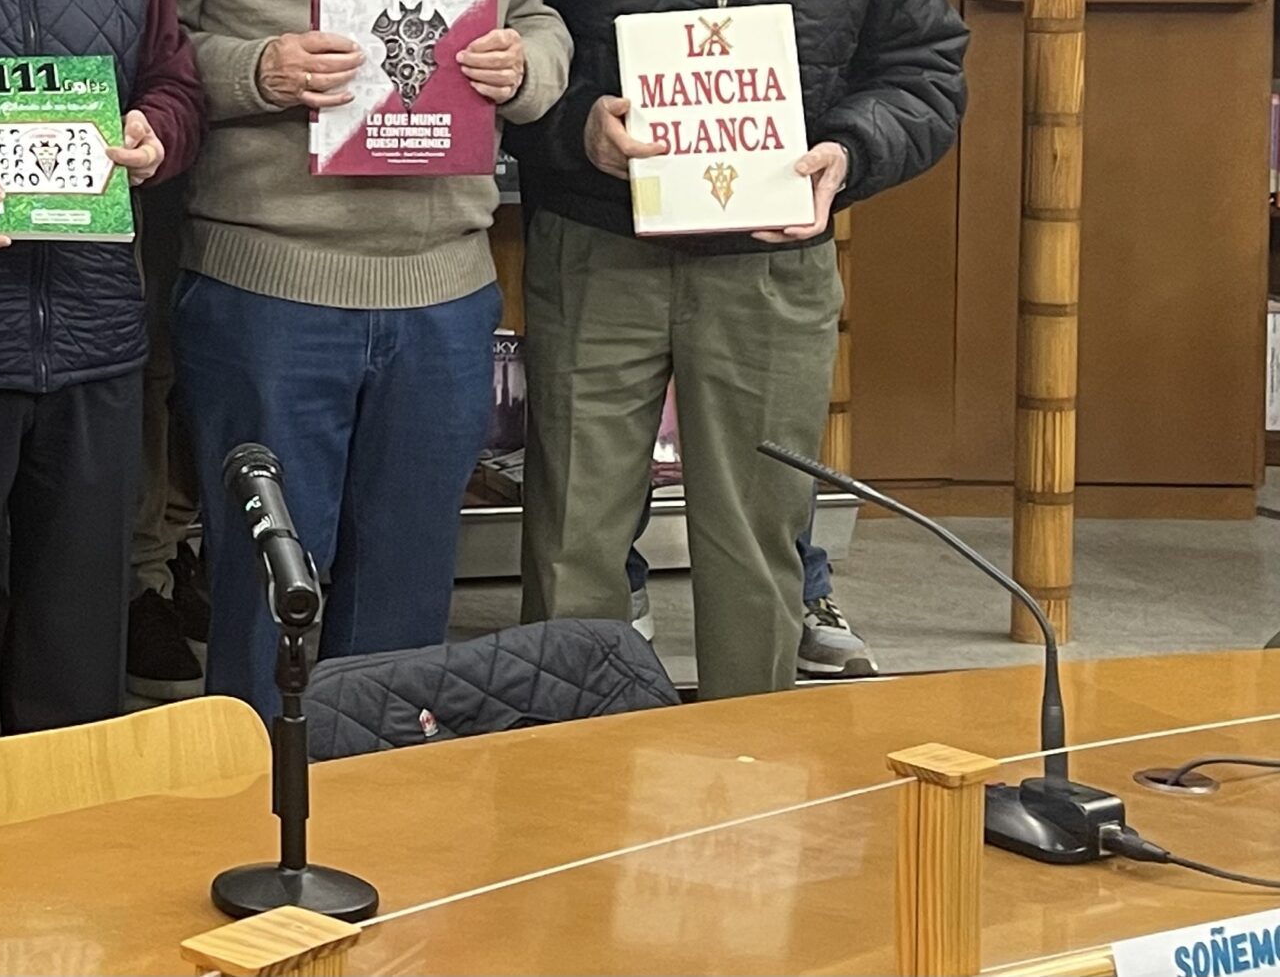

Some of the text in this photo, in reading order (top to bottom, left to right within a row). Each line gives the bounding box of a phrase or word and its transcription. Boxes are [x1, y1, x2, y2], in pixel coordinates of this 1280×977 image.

[684, 21, 732, 57] LA
[638, 67, 786, 108] MANCHA
[367, 114, 451, 126] LO QUE NUNCA
[366, 127, 378, 137] TE
[433, 127, 451, 137] DEL
[649, 116, 784, 156] BLANCA
[366, 138, 398, 149] QUESO
[493, 341, 519, 354] KY
